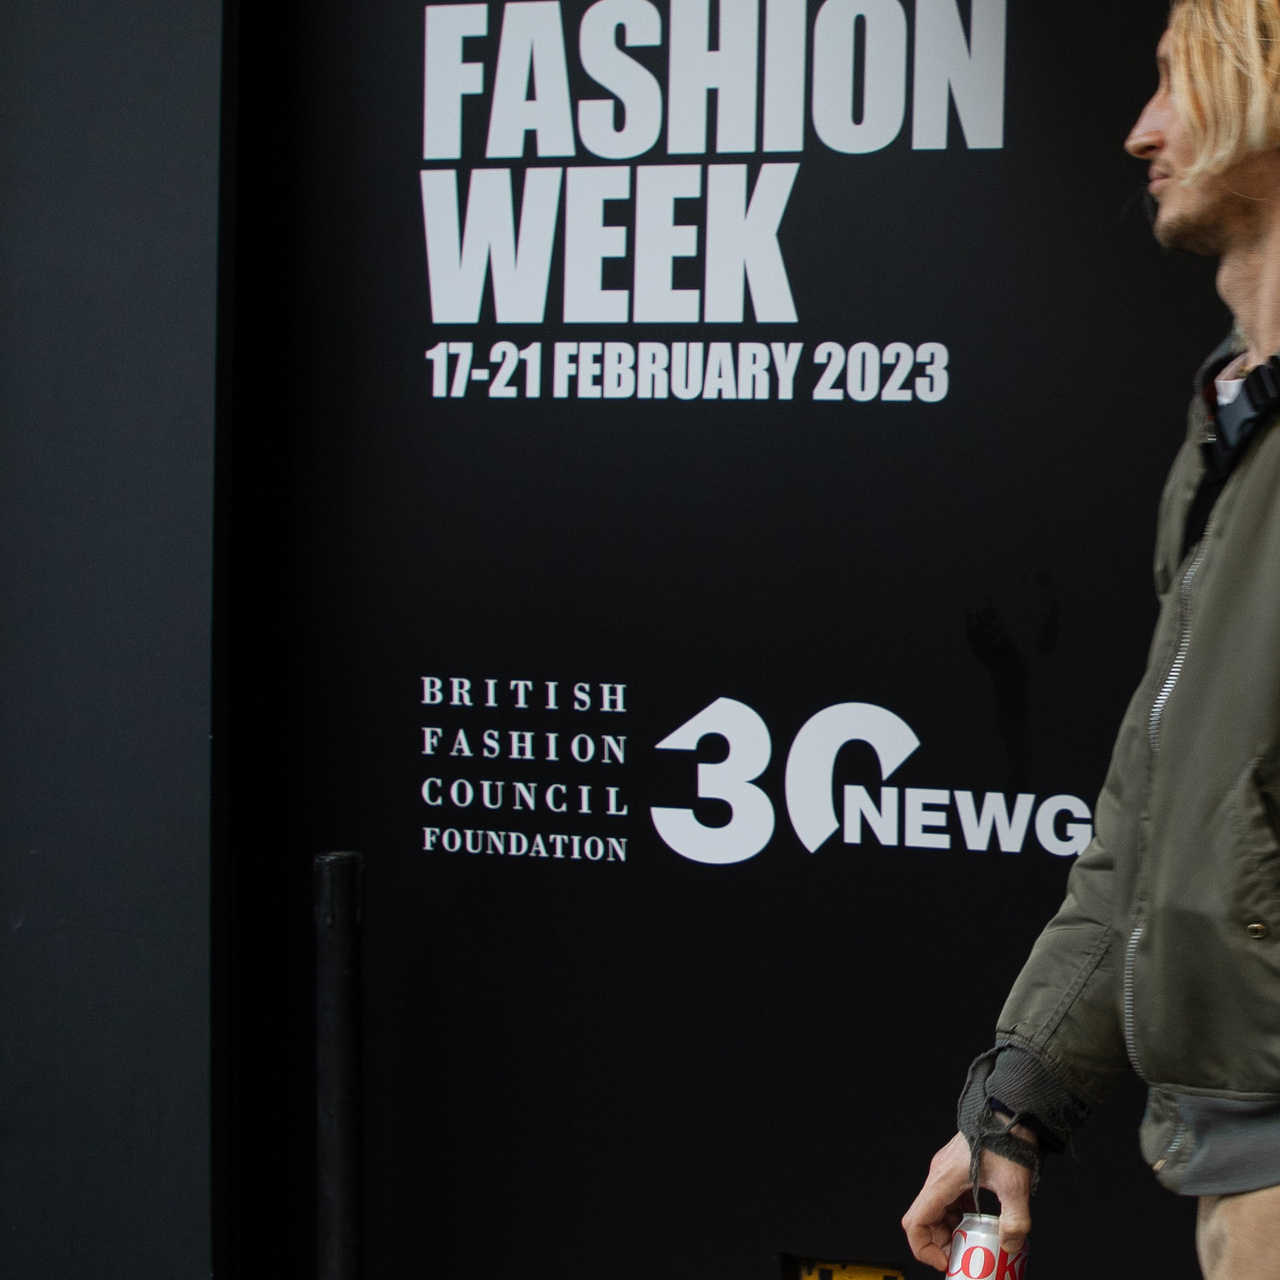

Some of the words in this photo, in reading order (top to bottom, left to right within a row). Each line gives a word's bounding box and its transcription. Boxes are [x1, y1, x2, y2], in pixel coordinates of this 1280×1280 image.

[419, 162, 801, 324] WEEK
[425, 340, 542, 399] 17-21
[552, 341, 804, 401] FEBRUARY
[812, 341, 949, 403] 2023
[420, 675, 628, 713] BRITISH
[420, 726, 628, 765] FASHION
[420, 777, 629, 816] COUNCIL
[421, 826, 629, 863] FOUNDATION
